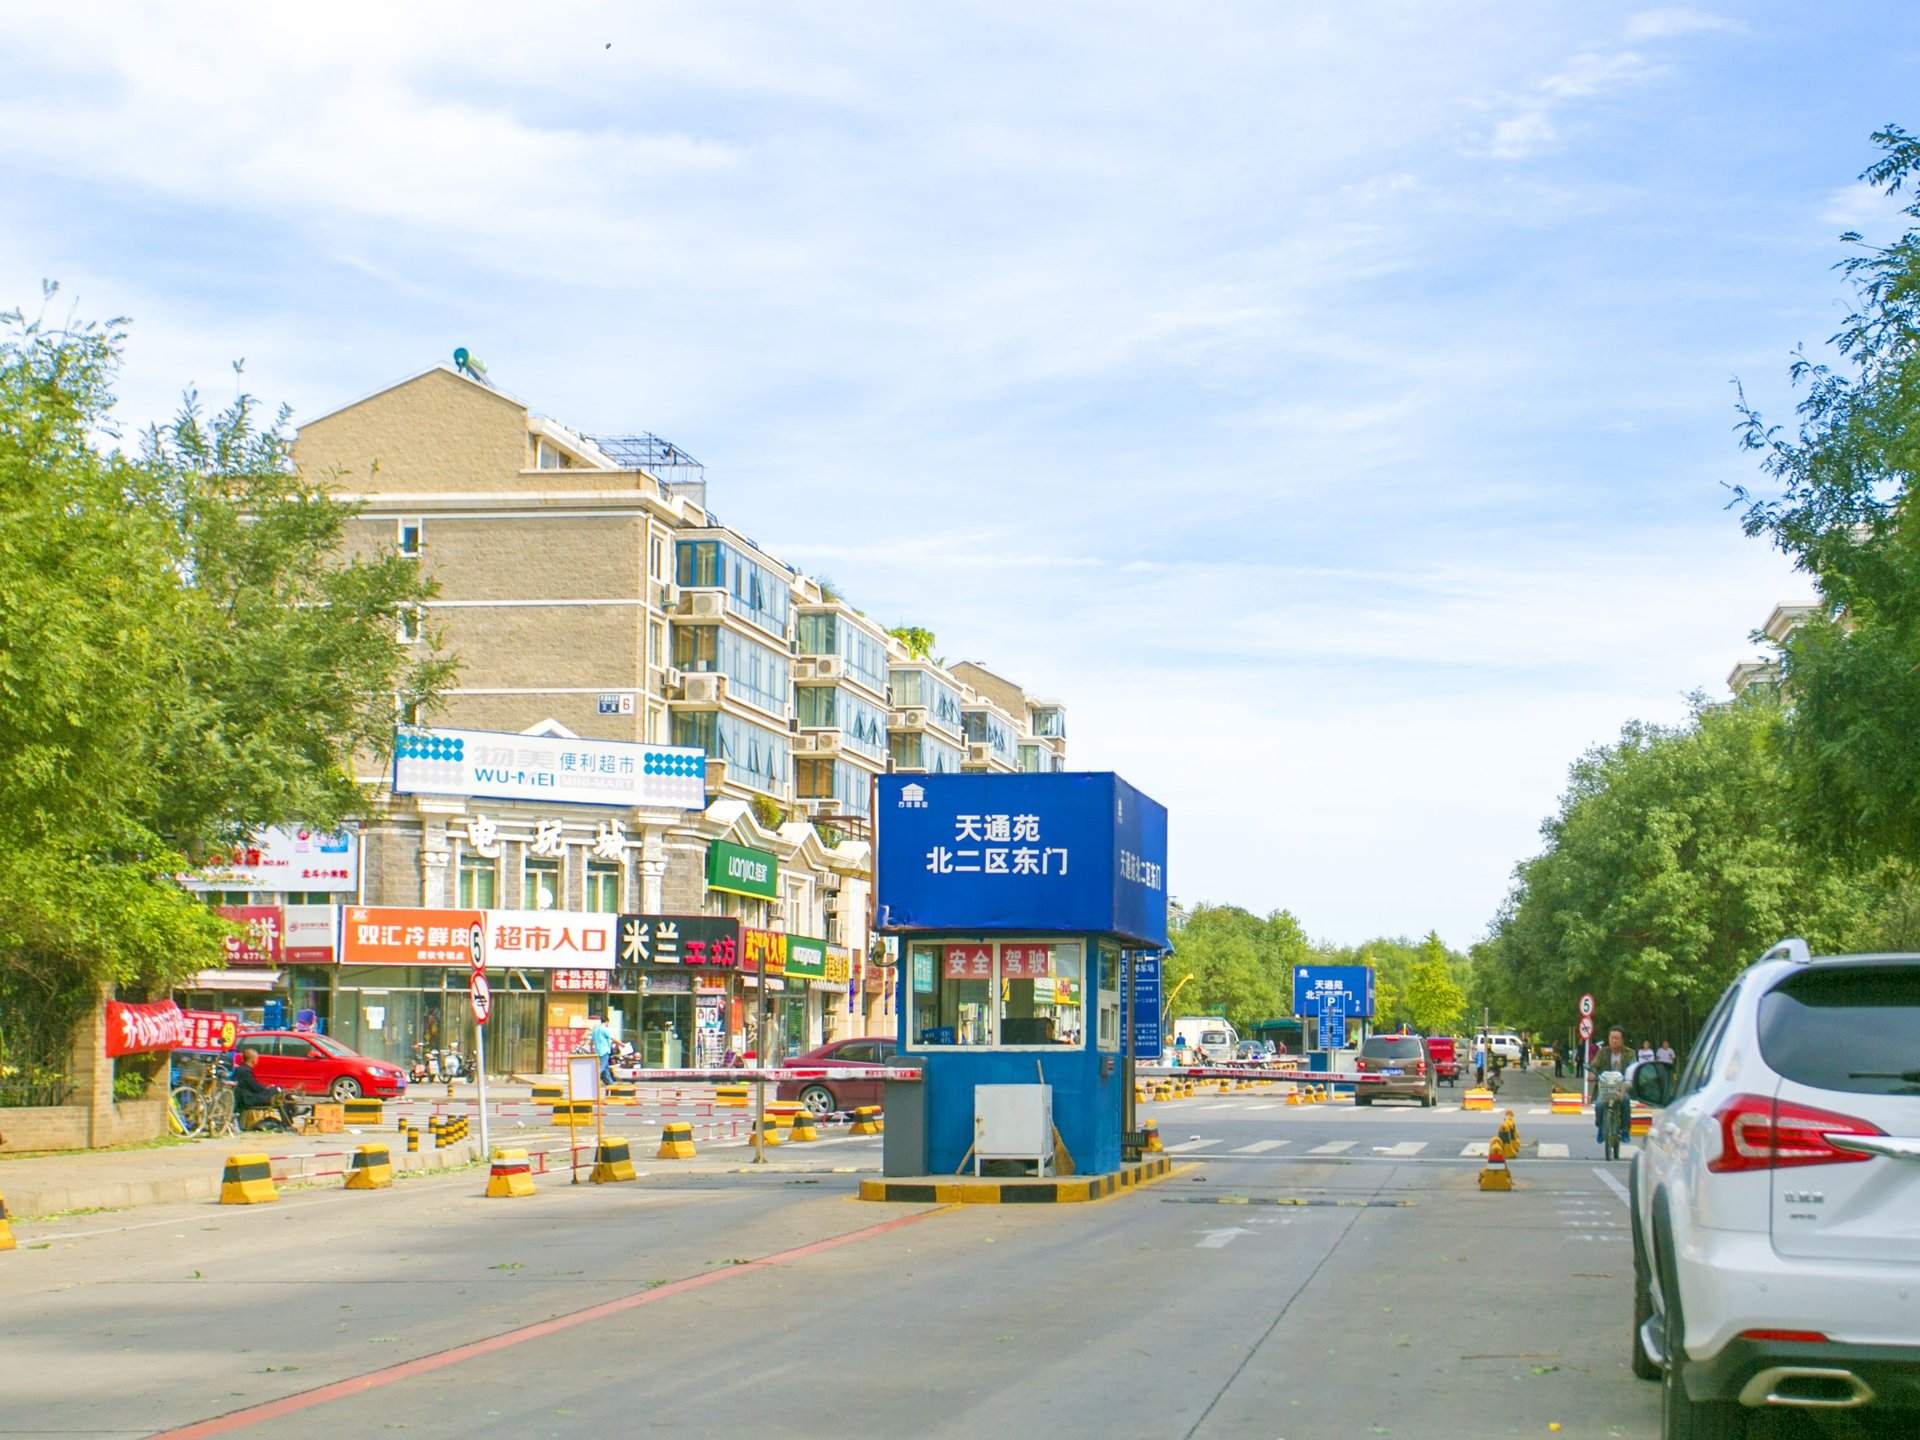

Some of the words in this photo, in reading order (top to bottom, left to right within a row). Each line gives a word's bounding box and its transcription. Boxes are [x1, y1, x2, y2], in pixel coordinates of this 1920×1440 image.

[623, 698, 631, 710] 6
[474, 745, 555, 770] 物美
[560, 751, 635, 774] 便利超市
[475, 768, 555, 787] WU-MEI
[561, 776, 633, 791] MINI-MART
[466, 813, 627, 865] 电玩城
[955, 813, 1041, 842] 天通苑
[926, 846, 1068, 875] 北二区东门
[1120, 849, 1161, 891] 天通苑北二区东门
[357, 925, 471, 947] 双汇冷鲜肉
[473, 932, 481, 963] 5
[494, 925, 607, 952] 超市入口
[622, 919, 736, 966] 米兰工坊
[950, 949, 990, 974] 安全
[1005, 949, 1046, 974] 驾驶
[1315, 980, 1343, 990] 天通苑
[1327, 997, 1336, 1007] P
[1583, 998, 1590, 1013] 5
